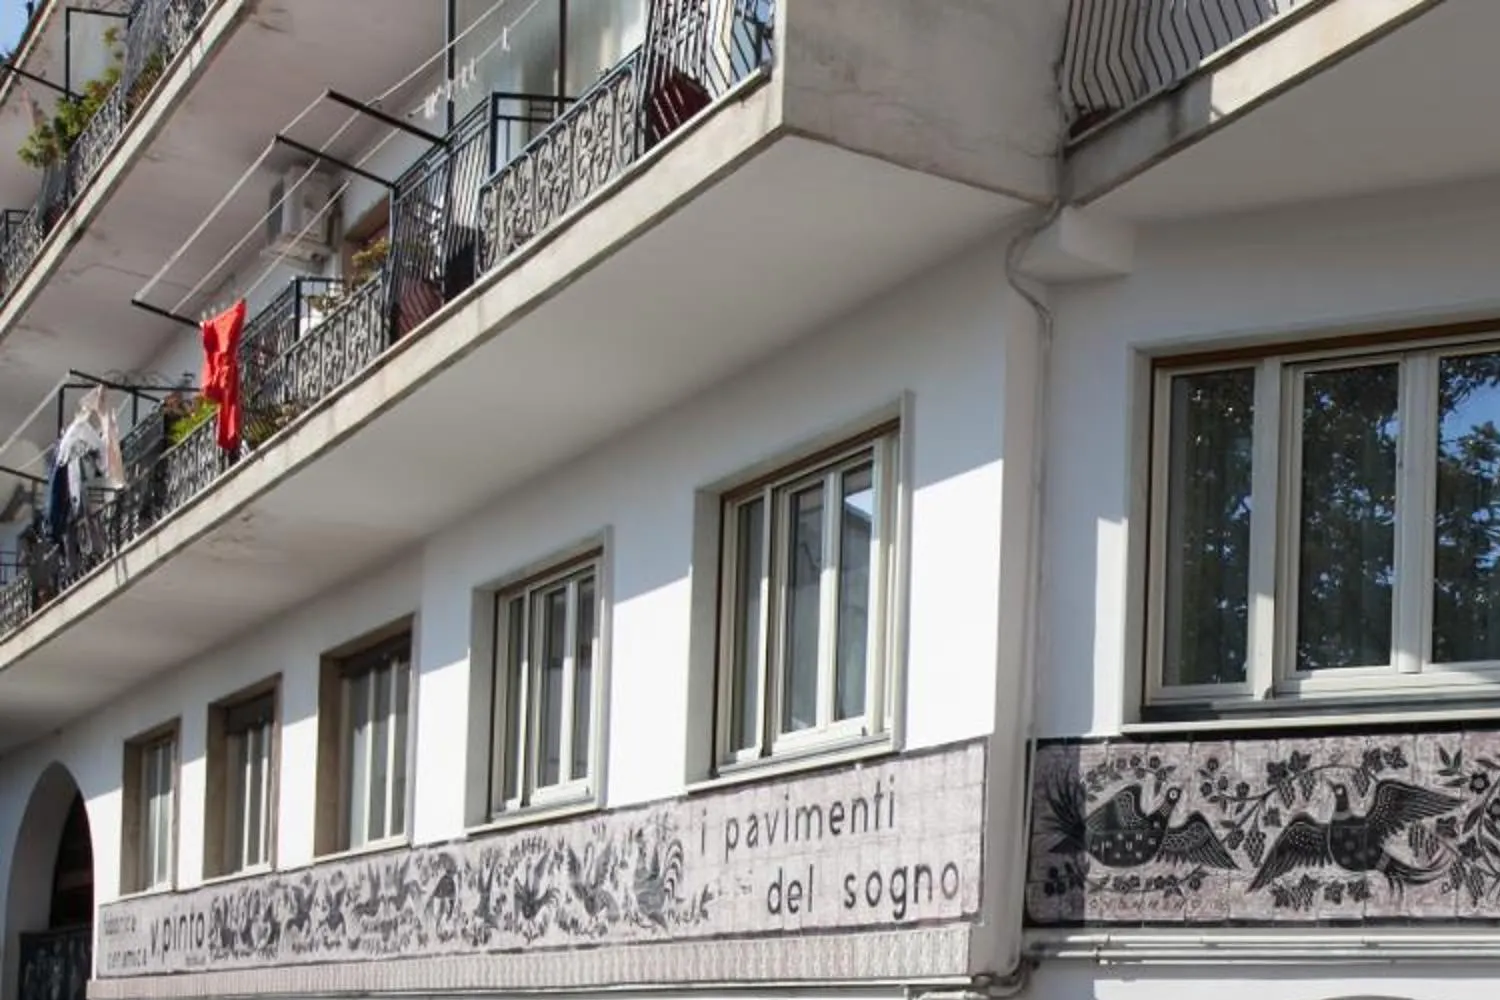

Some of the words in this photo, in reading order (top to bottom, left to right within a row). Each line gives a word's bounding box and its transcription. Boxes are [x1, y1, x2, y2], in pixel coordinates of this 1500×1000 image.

[700, 807, 709, 856] i
[725, 776, 896, 864] pavimenti
[766, 865, 814, 915] del
[843, 861, 960, 920] sogno
